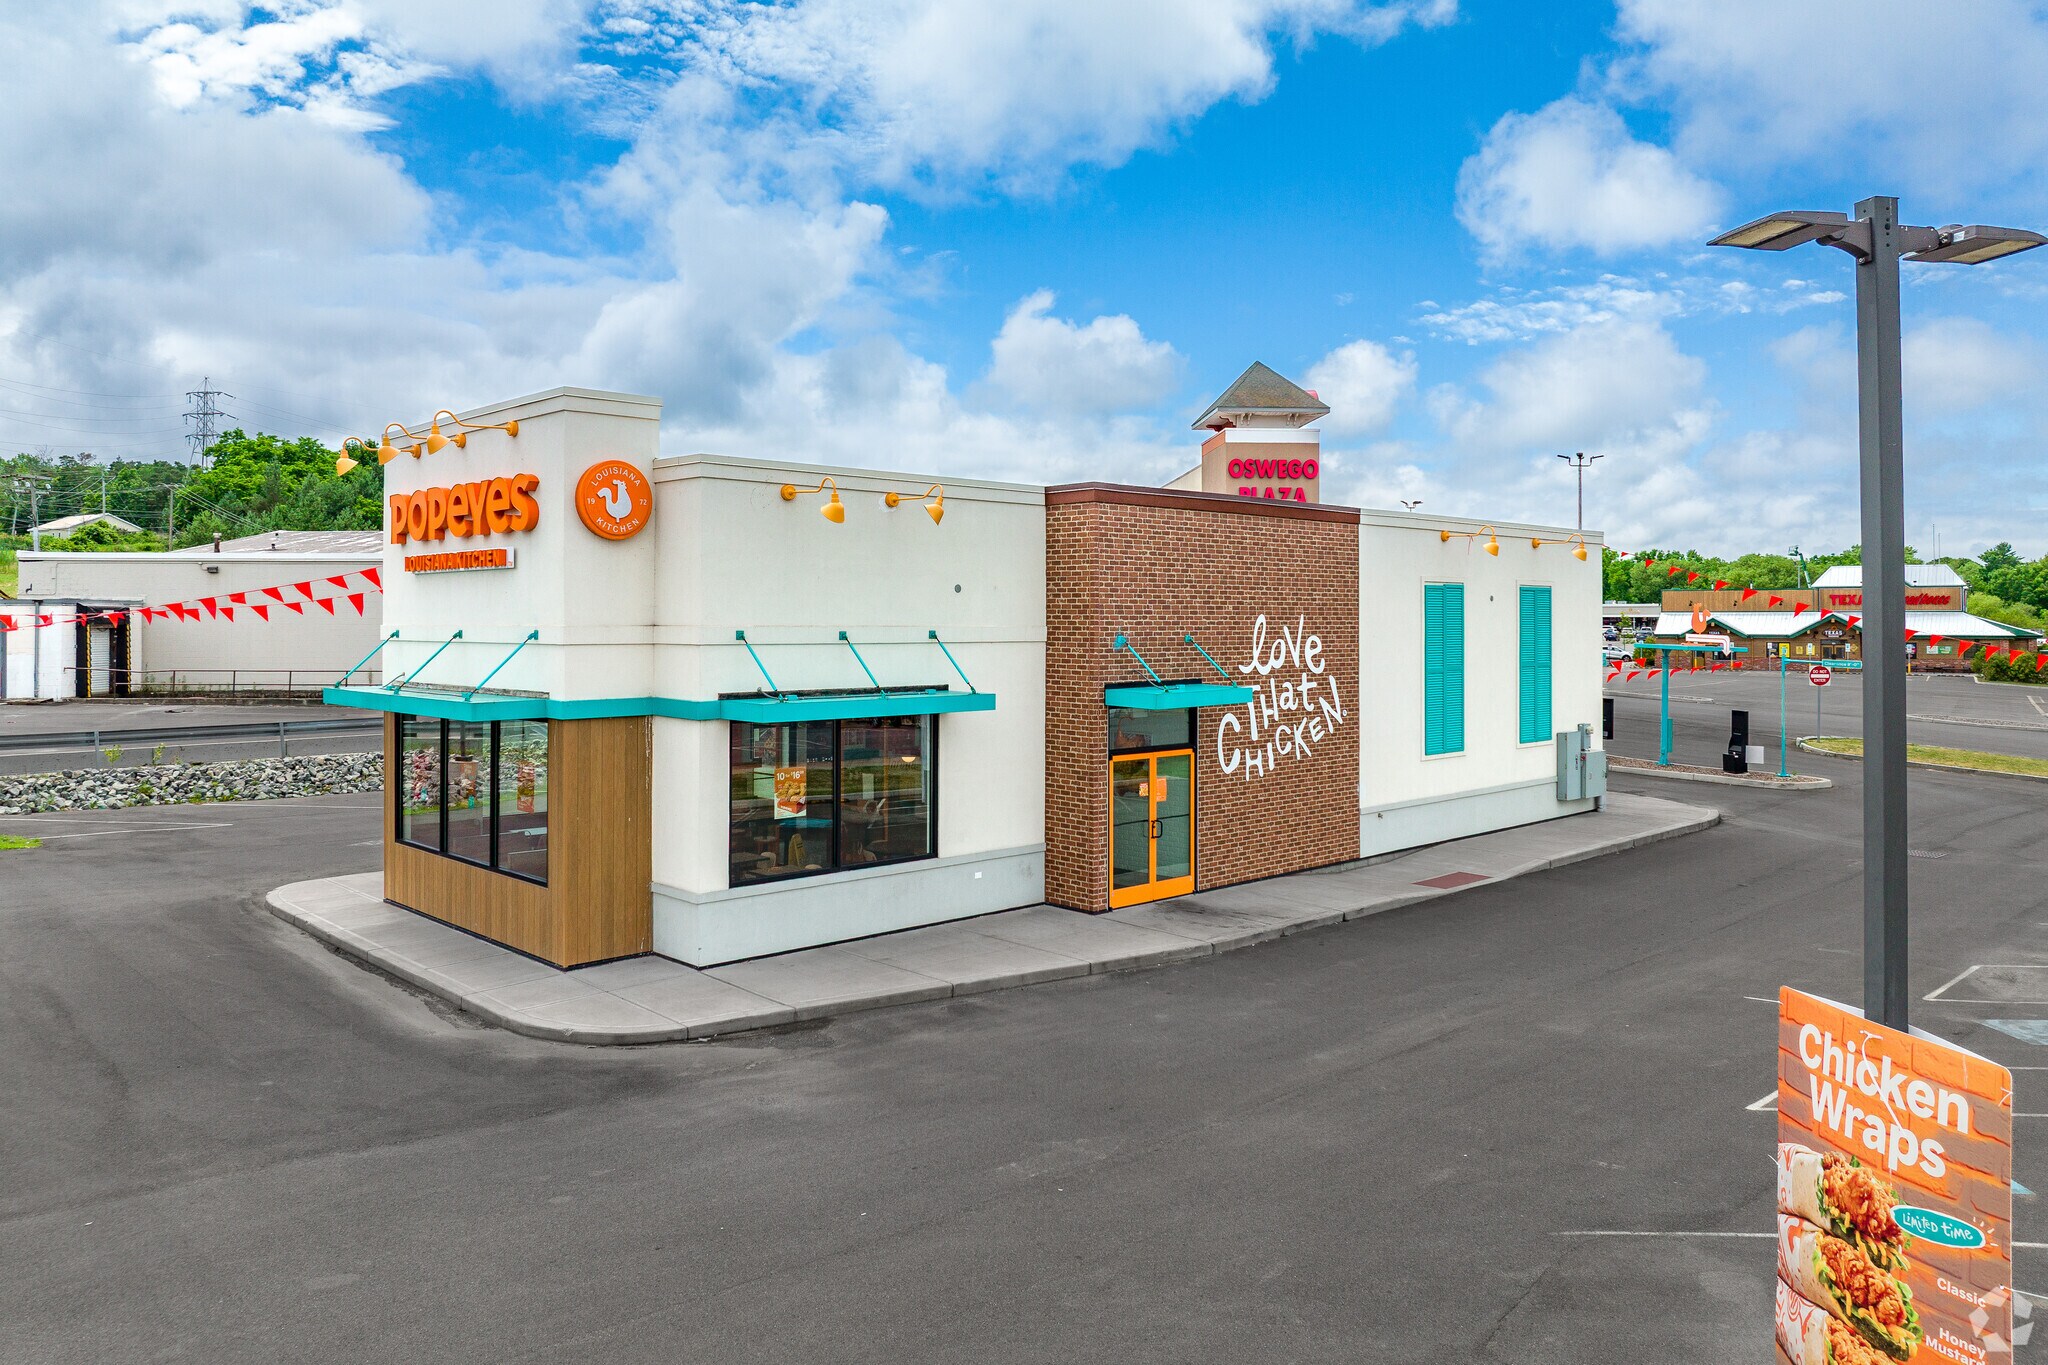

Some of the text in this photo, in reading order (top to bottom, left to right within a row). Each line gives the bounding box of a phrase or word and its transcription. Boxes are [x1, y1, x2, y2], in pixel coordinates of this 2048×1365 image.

[591, 467, 641, 486] LOUISIANA
[1228, 458, 1319, 479] OSWEGO
[596, 517, 639, 533] KITCHEN
[405, 549, 507, 572] LOUISIANA KITCHEN
[1829, 594, 1863, 606] TEX
[776, 772, 785, 781] 10
[1799, 1023, 1969, 1135] Chicken
[1809, 1073, 1947, 1178] Wraps
[1936, 1277, 1986, 1308] Classic
[1939, 1327, 1986, 1360] Honey
